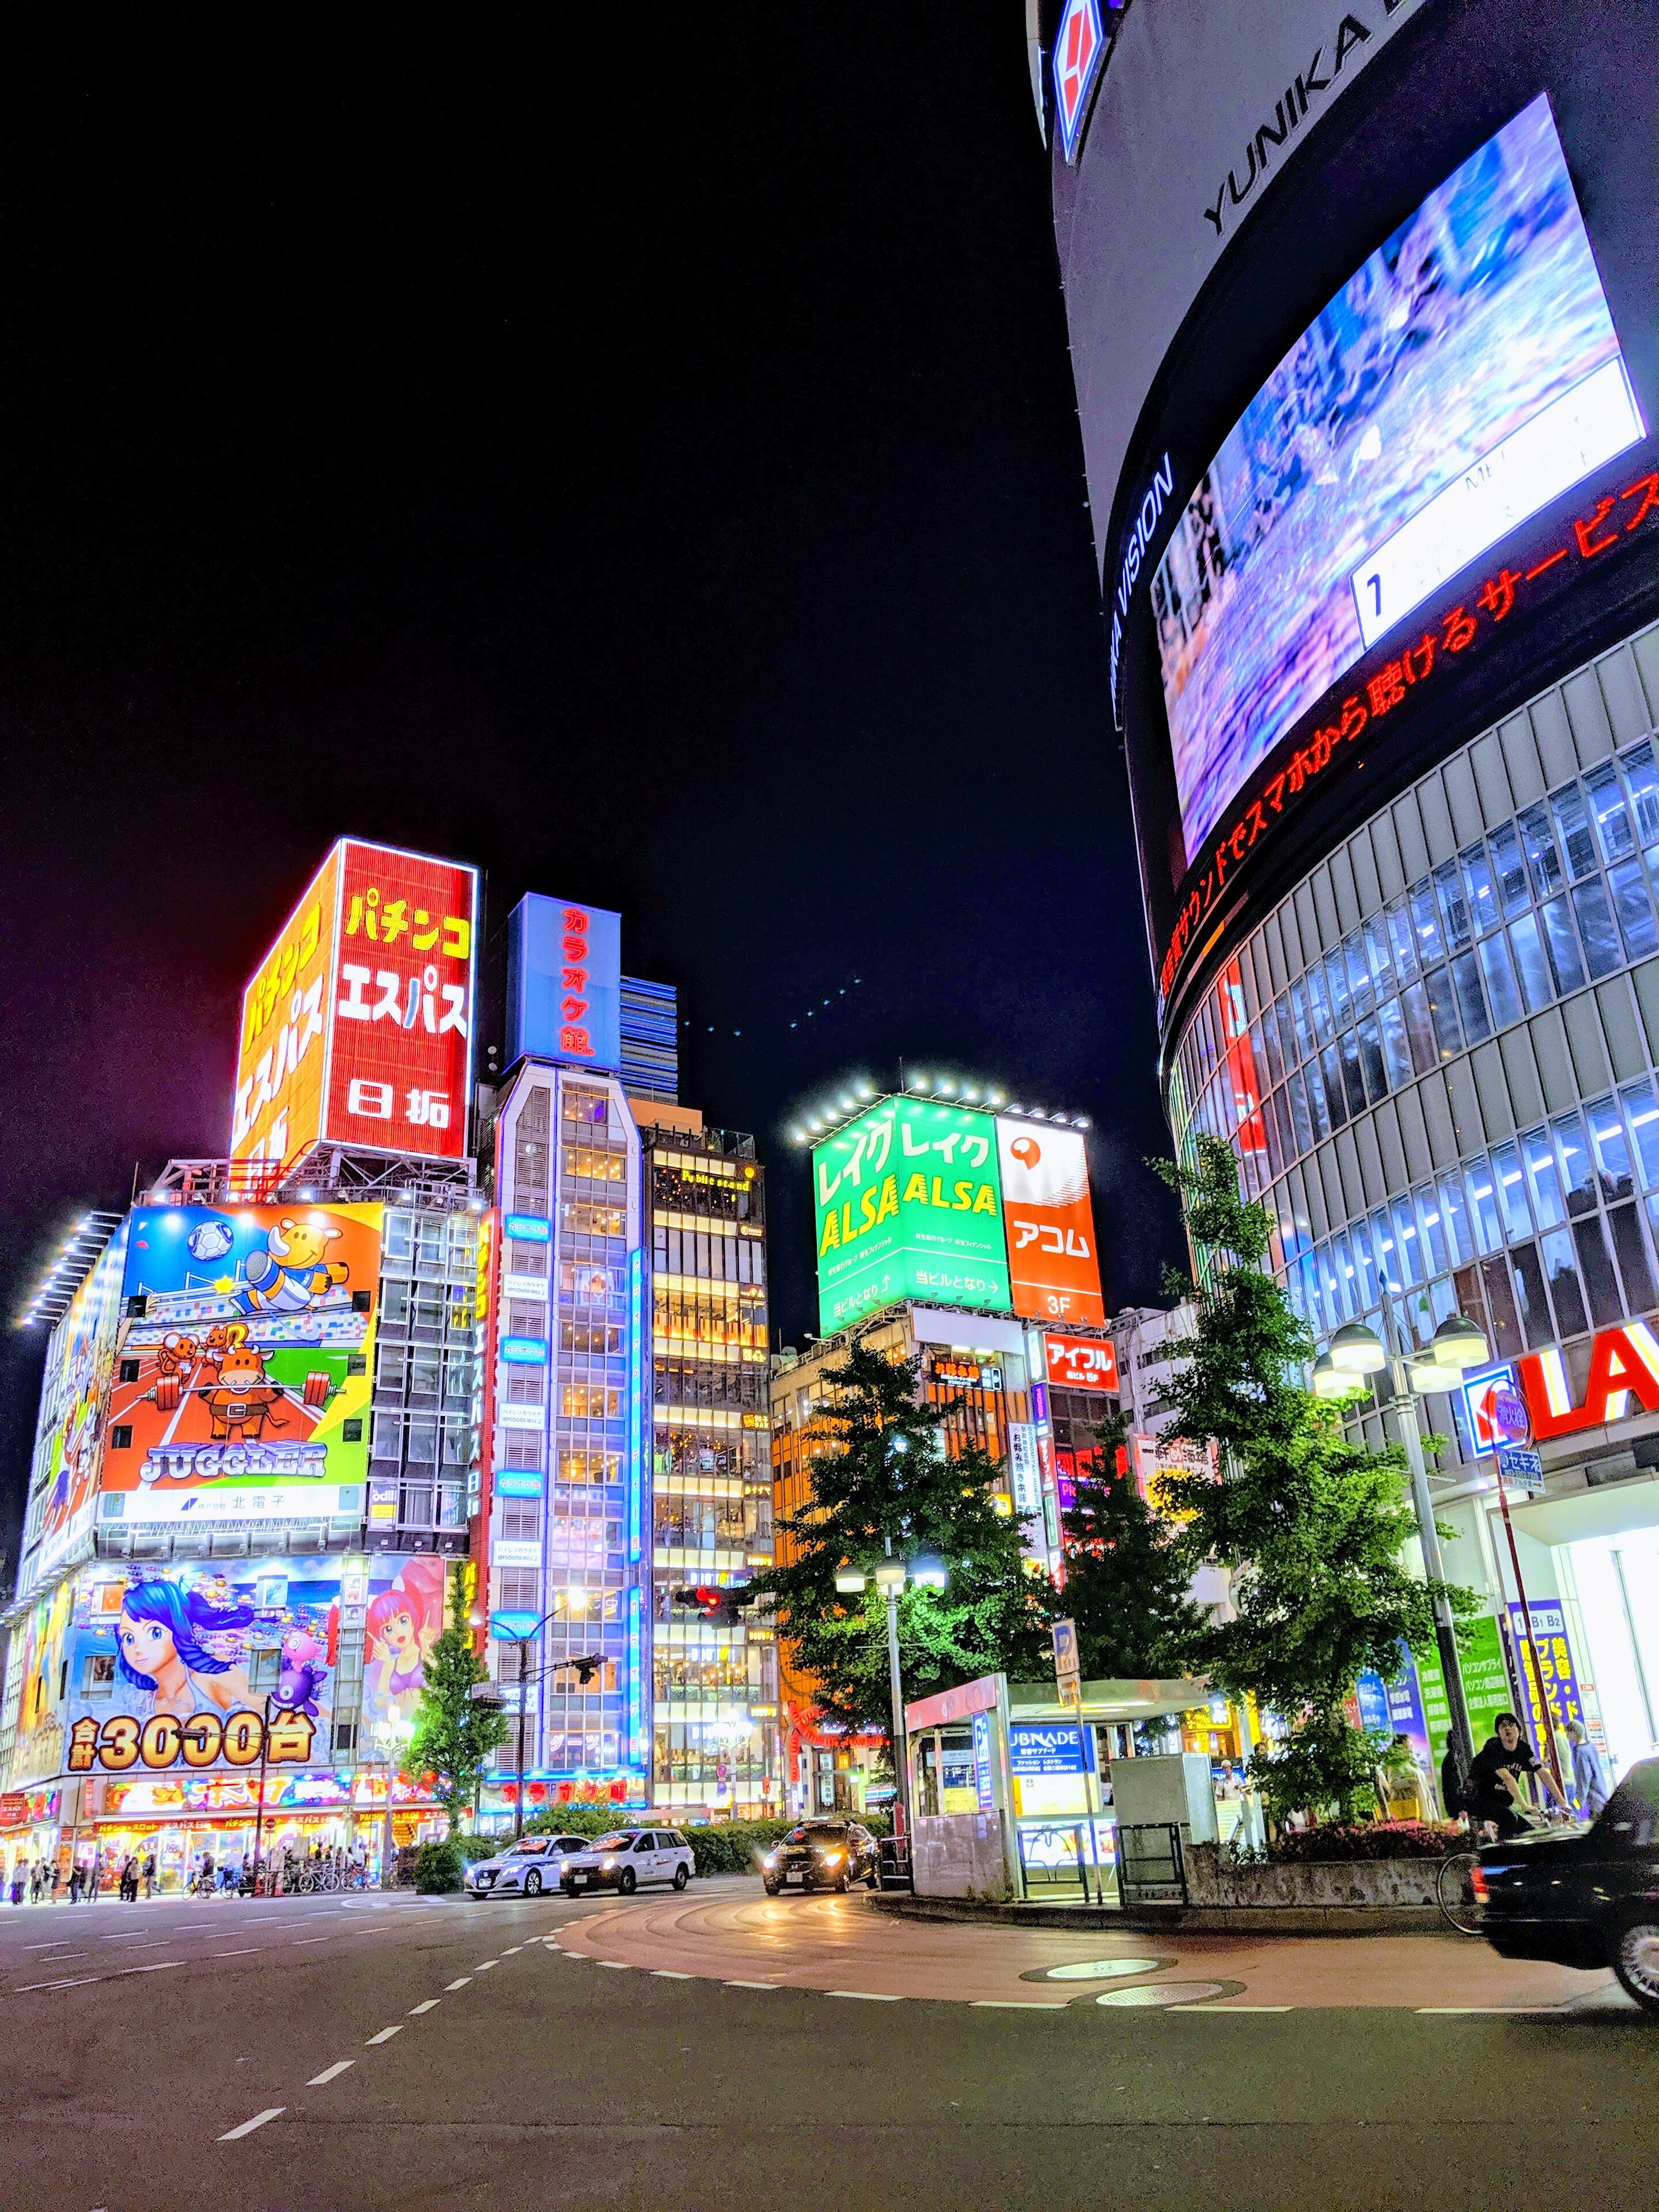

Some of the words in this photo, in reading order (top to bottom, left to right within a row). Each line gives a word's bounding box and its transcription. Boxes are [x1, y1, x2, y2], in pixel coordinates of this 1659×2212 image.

[1204, 14, 1370, 236] YUNIKA
[1118, 452, 1173, 616] VISION
[347, 887, 469, 959] パチンコ
[245, 902, 321, 1054] パチンコ
[560, 907, 589, 1056] カラオケ館
[339, 964, 468, 1038] エスパス
[231, 973, 323, 1154] エスパス
[348, 1078, 450, 1129] 日拓
[819, 1119, 892, 1207] レイク
[902, 1123, 989, 1168] レイク
[681, 1169, 714, 1185] Public
[717, 1180, 750, 1192] stand
[902, 1172, 997, 1217] ALSA
[509, 1223, 548, 1234] カラオケ館
[819, 1173, 900, 1257] ALSA
[1013, 1220, 1090, 1259] アコム
[833, 1284, 878, 1317] 当ビルとなり
[916, 1270, 986, 1292] 当ビルとなり
[1047, 1296, 1071, 1315] 3F
[505, 1346, 545, 1356] カラオケ館
[1048, 1343, 1112, 1372] アイフル
[140, 1443, 327, 1480] JUGGLER
[232, 1495, 285, 1509] 北電子
[500, 1479, 541, 1490] カラオケ館
[1547, 1615, 1560, 1627] B2
[549, 1734, 600, 1752] ダーツ
